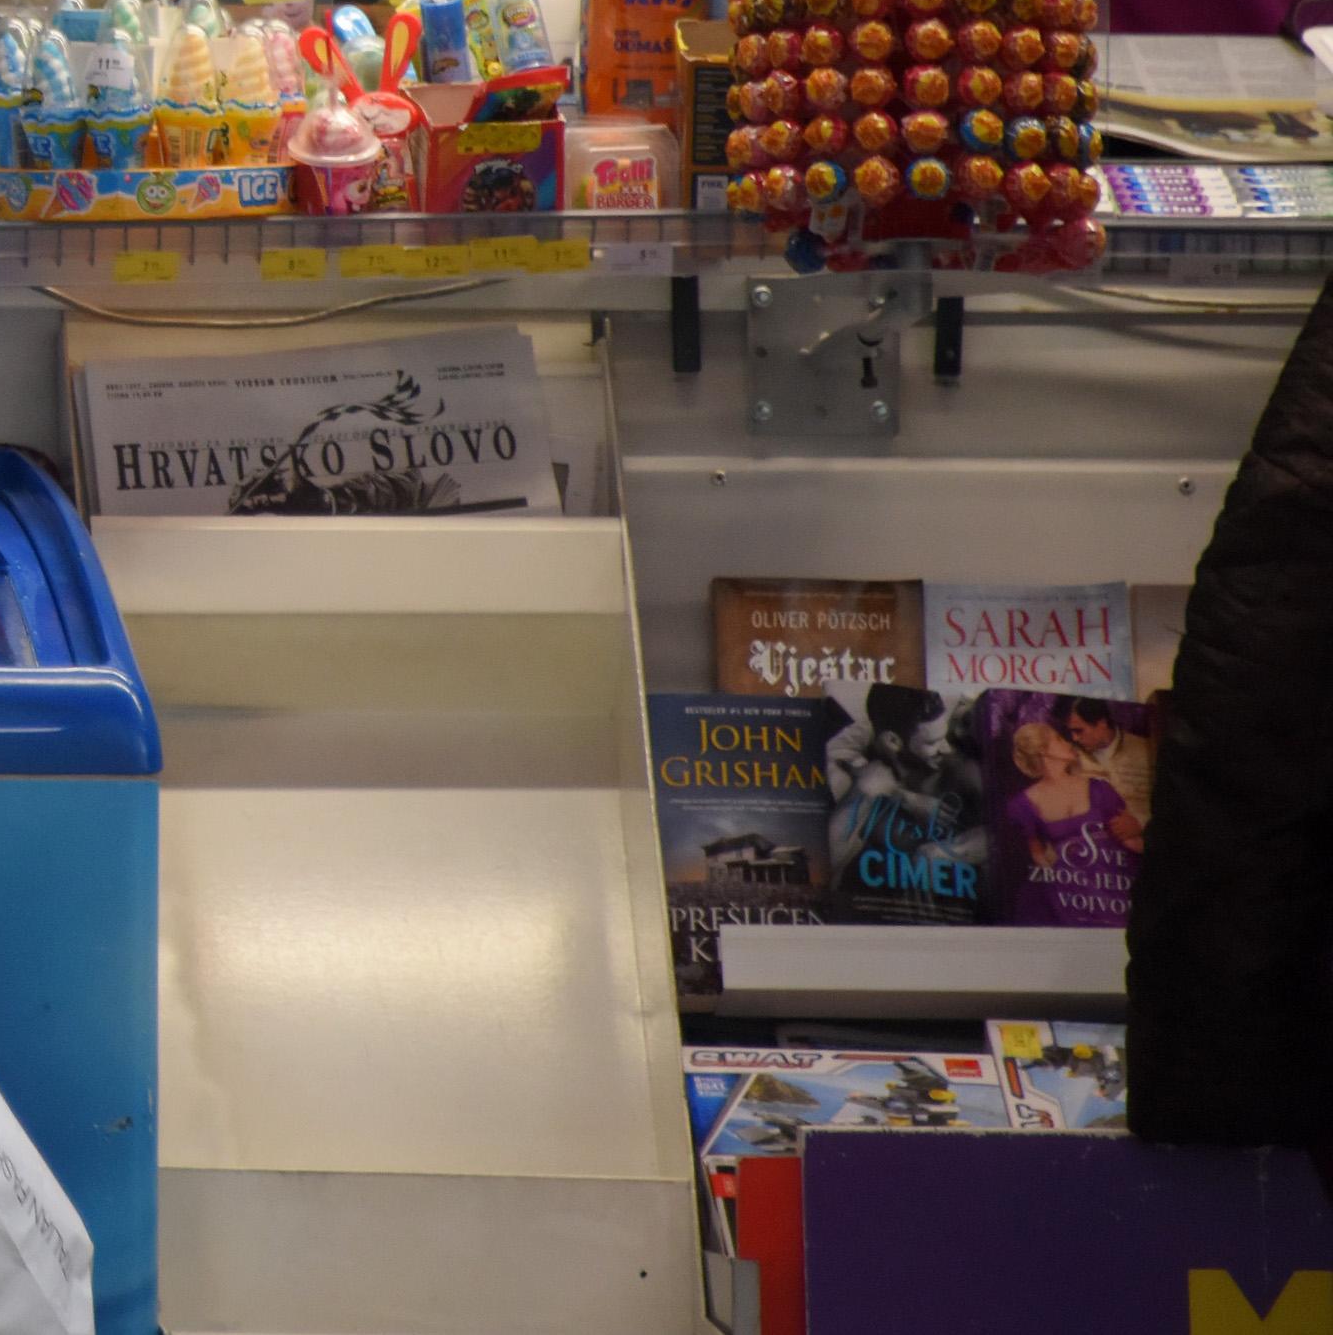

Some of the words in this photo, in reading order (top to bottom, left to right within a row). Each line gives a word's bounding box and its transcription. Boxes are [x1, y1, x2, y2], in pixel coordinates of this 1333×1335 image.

[244, 174, 279, 201] ICE
[113, 440, 345, 492] HRVATSKO
[370, 424, 518, 473] SLOVO
[750, 610, 810, 630] OLIVER
[943, 605, 1113, 651] SARAH
[748, 639, 896, 699] Vještac
[945, 652, 1114, 687] MORGAN
[697, 718, 802, 754] JOHN
[858, 849, 978, 900] CIMER
[1027, 866, 1089, 888] ZBOG
[1094, 871, 1131, 892] JED
[1056, 891, 1132, 914] VOJVO
[690, 1050, 823, 1071] SWAT
